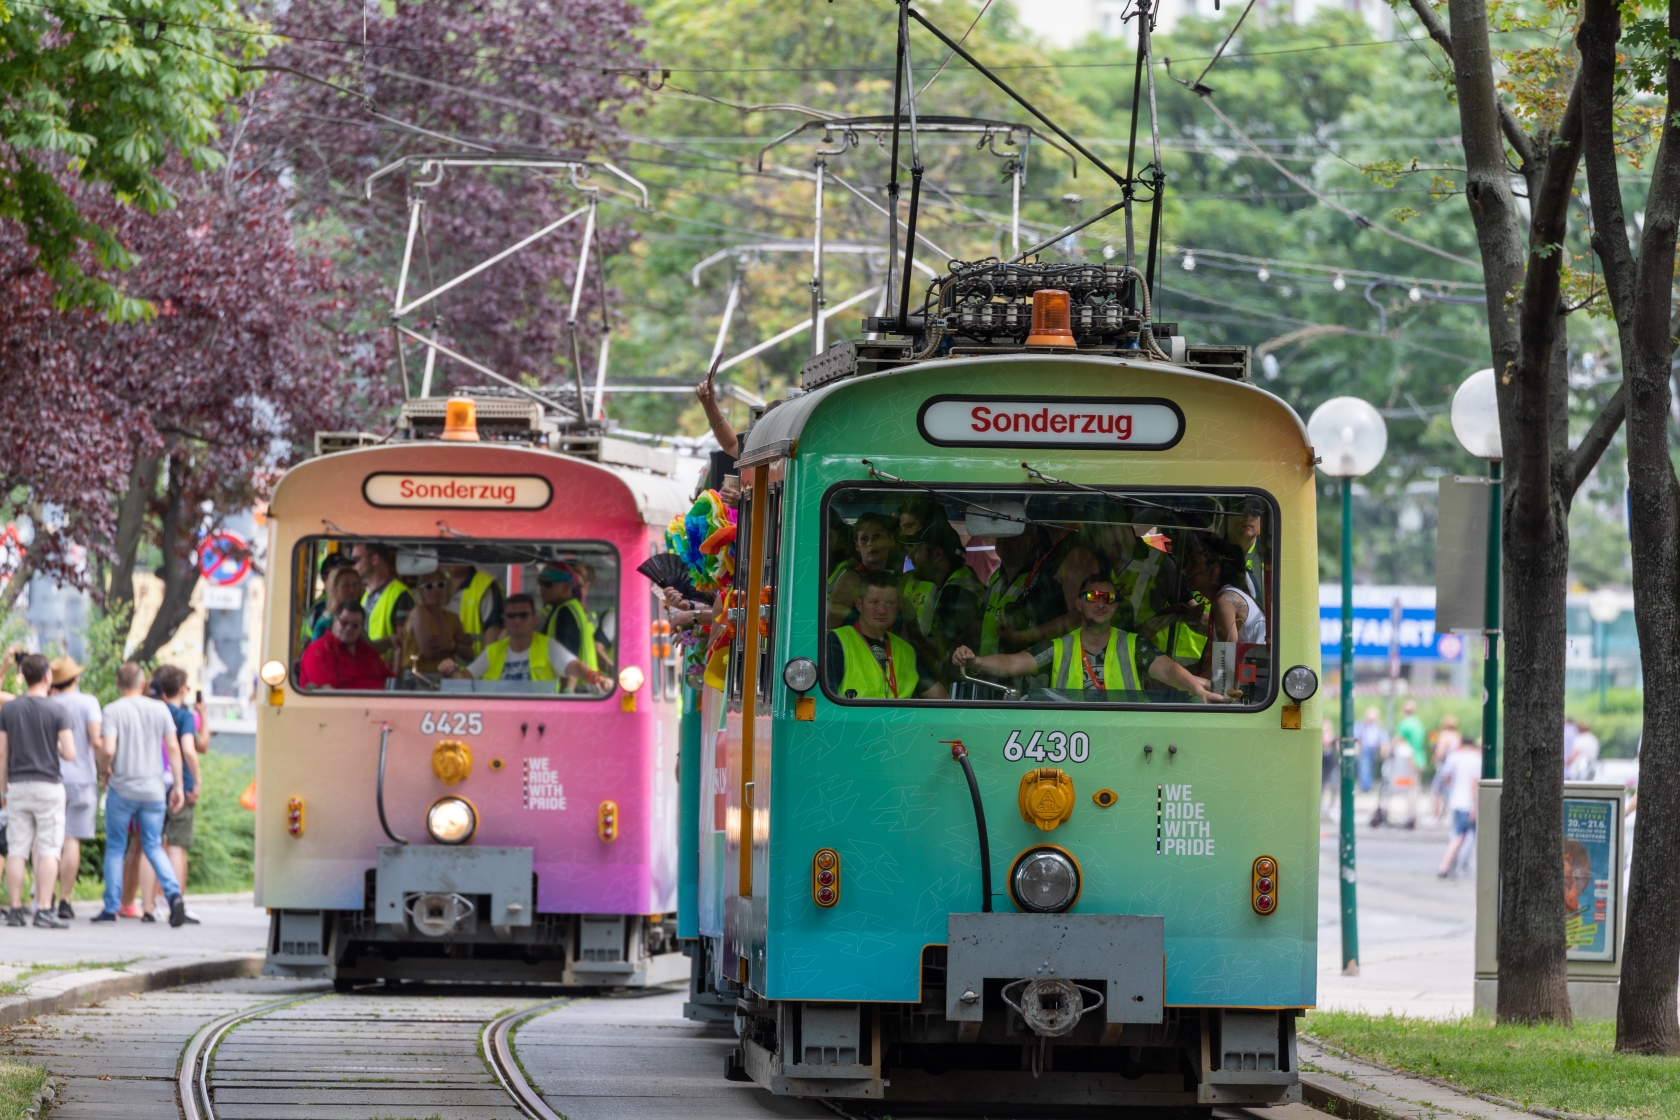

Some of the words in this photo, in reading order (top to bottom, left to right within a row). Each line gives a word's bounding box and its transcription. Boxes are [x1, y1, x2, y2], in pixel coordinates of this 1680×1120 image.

[971, 406, 1132, 440] Sonderzug
[400, 479, 515, 504] Sonderzug
[420, 711, 483, 736] 6425
[1003, 730, 1090, 763] 6430
[529, 757, 549, 770] WE
[529, 770, 558, 784] RIDE
[529, 784, 563, 797] WITH
[1165, 784, 1192, 801] WE
[529, 797, 567, 810] PRIDE
[1165, 802, 1205, 819] RIDE
[1164, 820, 1210, 838] WITH
[1164, 838, 1215, 856] PRIDE
